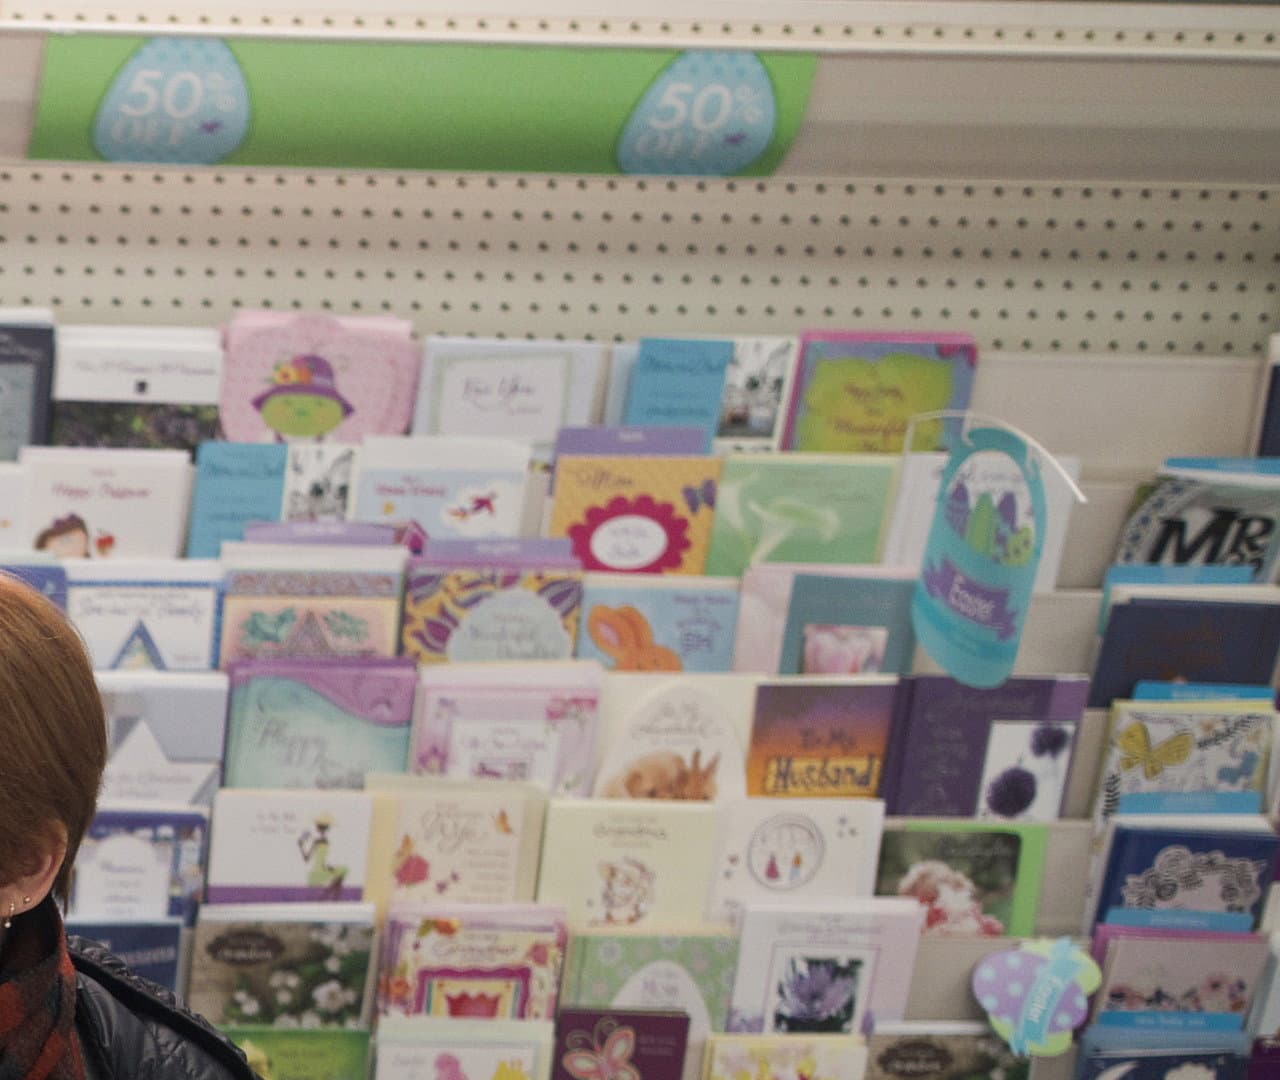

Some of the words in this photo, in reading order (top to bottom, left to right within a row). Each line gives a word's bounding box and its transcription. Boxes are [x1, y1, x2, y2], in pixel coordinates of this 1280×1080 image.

[120, 71, 237, 119] 50%
[647, 82, 766, 131] 50%
[774, 753, 876, 789] Husband
